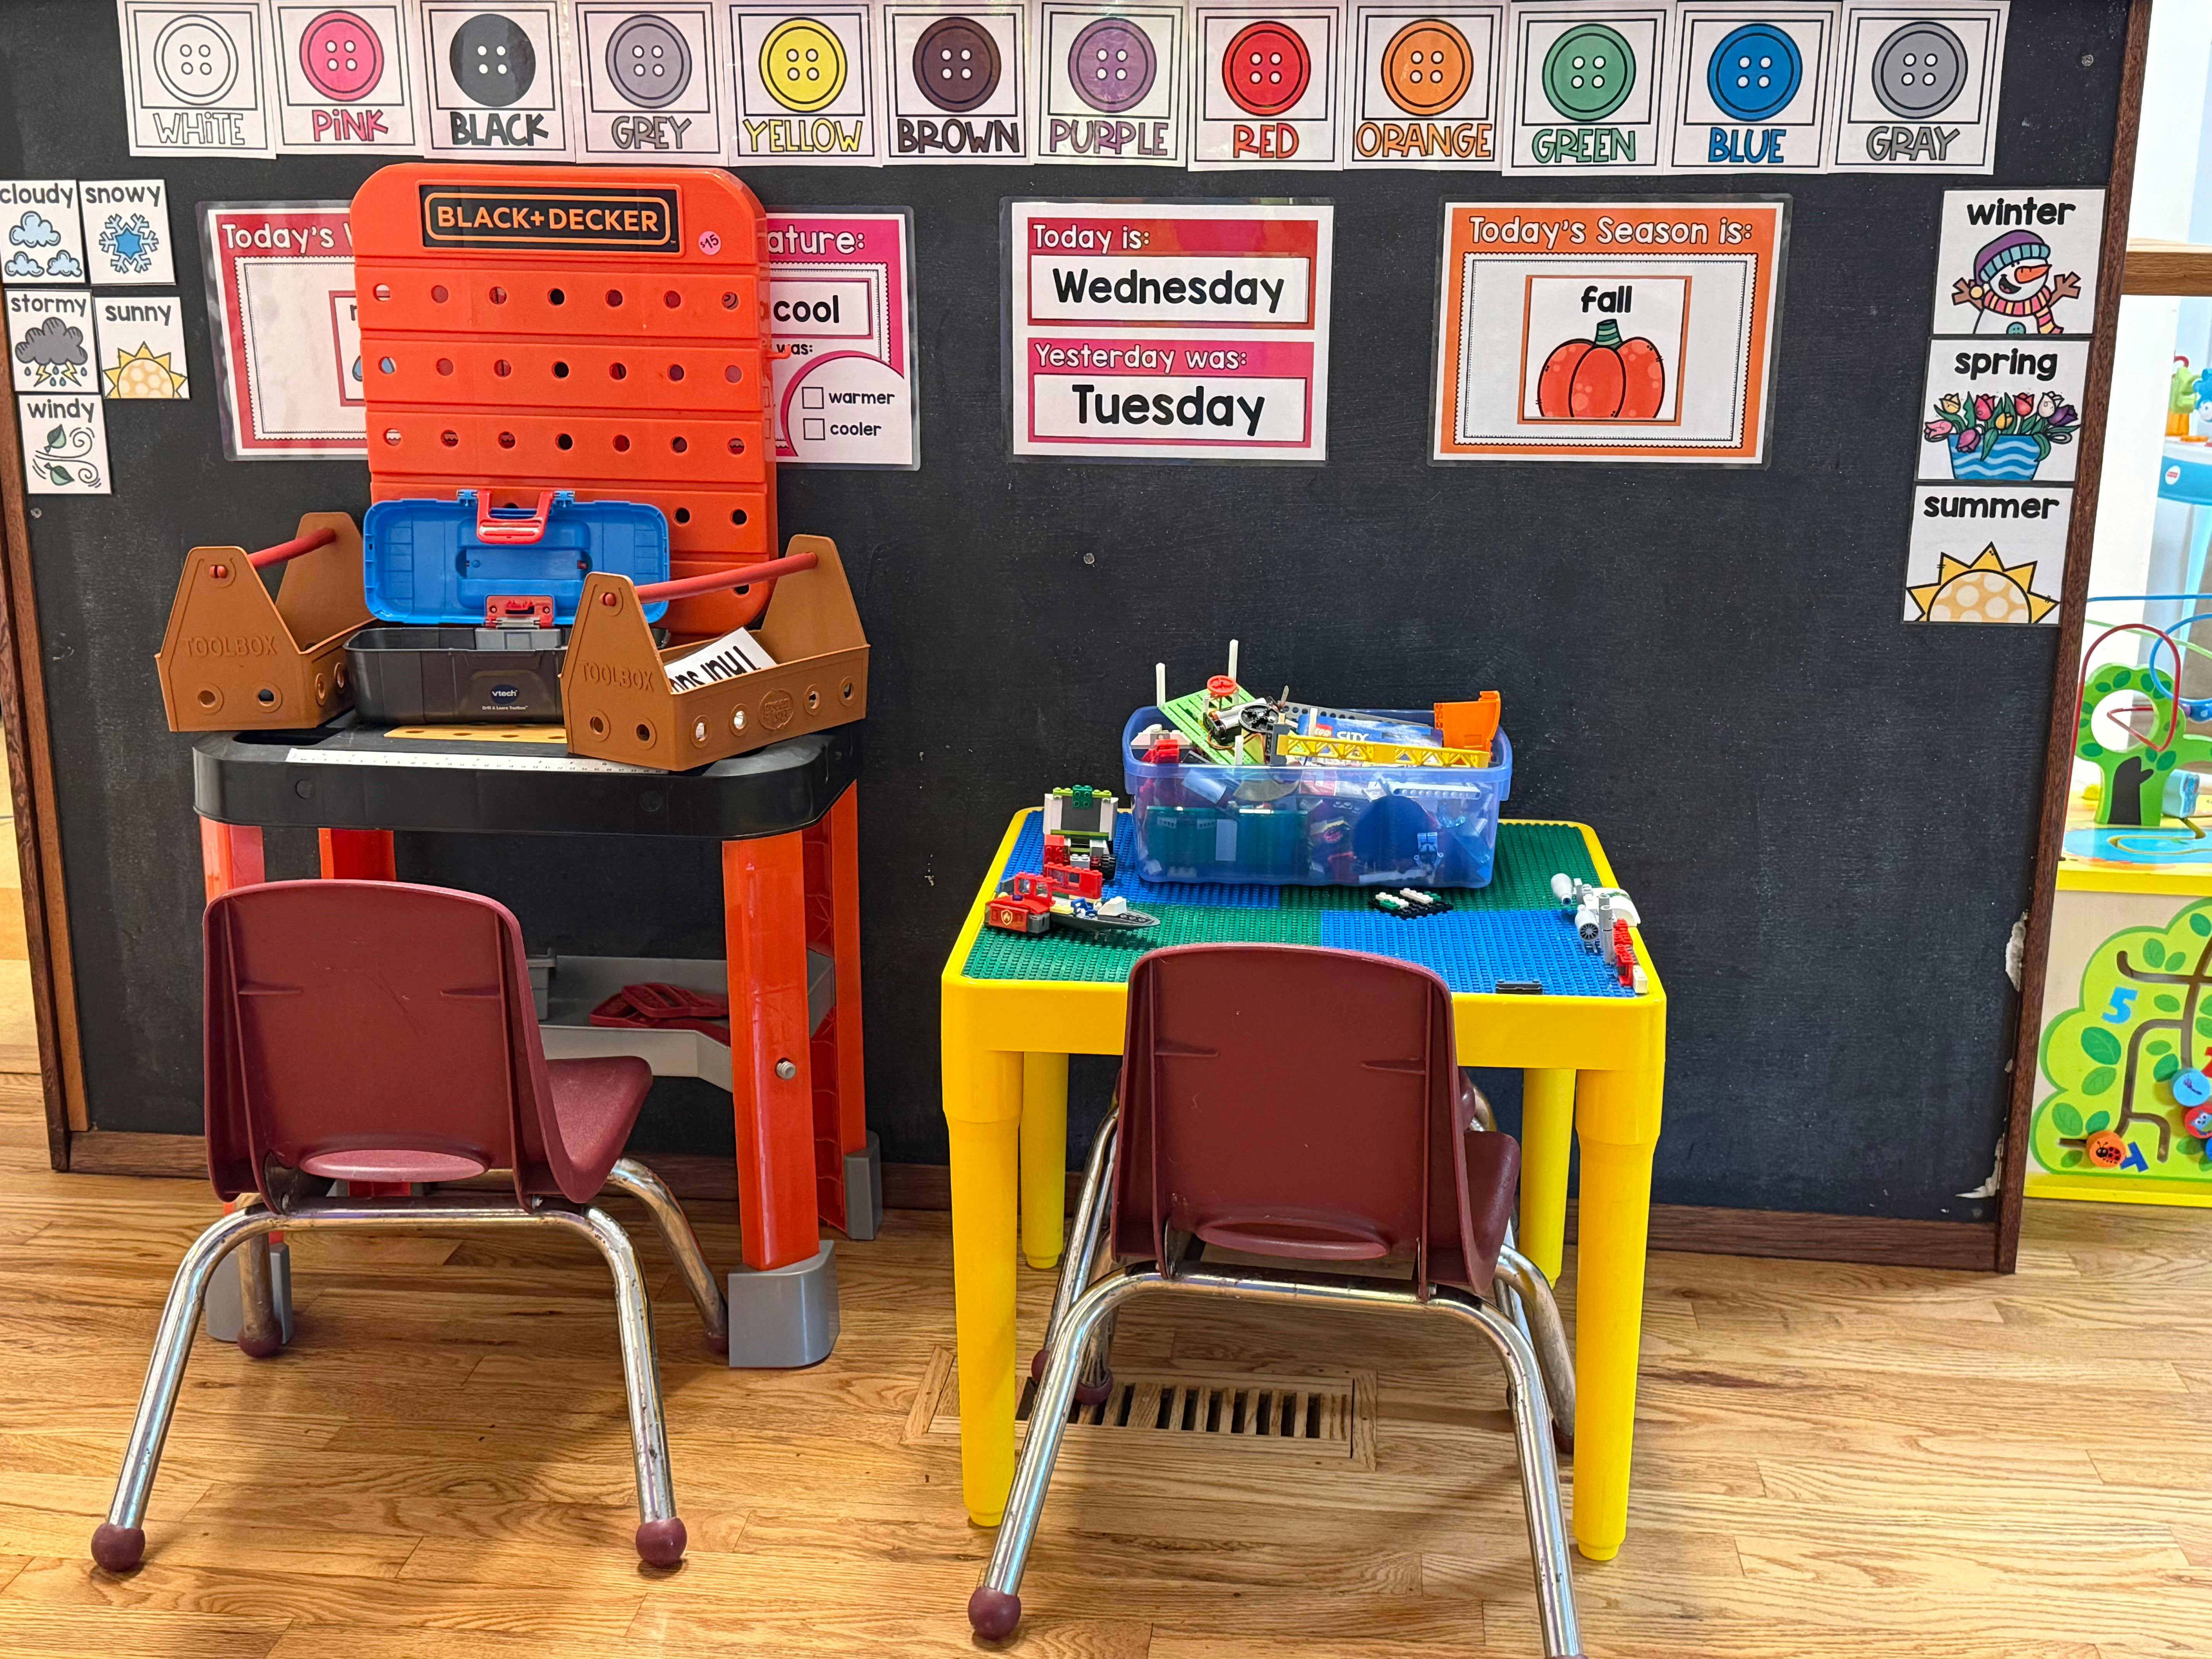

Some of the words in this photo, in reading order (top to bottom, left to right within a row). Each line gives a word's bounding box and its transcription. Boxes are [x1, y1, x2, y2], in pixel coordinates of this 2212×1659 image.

[450, 111, 549, 146] BLACK
[611, 116, 692, 151] GREY
[743, 118, 863, 153] YELLOW
[897, 118, 1020, 154] BROWN
[1050, 119, 1169, 156] PURPLE
[1233, 123, 1299, 159] RED
[1357, 122, 1492, 158] ORANGE
[1866, 125, 1960, 161] GRAY
[1531, 128, 1636, 164] GREEN
[1709, 127, 1787, 164] BLUE
[0, 182, 74, 207] cloudy
[86, 182, 161, 207] snowy
[1966, 197, 2076, 225] winter
[221, 223, 335, 254] Today's
[700, 234, 719, 248] $15
[768, 224, 865, 255] ature:
[1032, 223, 1113, 254] Today
[1122, 226, 1151, 250] is:
[1470, 216, 1586, 251] Today's
[1596, 216, 1708, 247] Season
[1717, 217, 1753, 246] is:
[11, 294, 87, 317] stormy
[1053, 268, 1285, 314] Wednesday
[1581, 285, 1633, 314] fall
[105, 303, 172, 326] sunny
[773, 295, 840, 323] cool
[1034, 343, 1175, 374] Yesterday
[1185, 350, 1247, 370] was:
[1954, 348, 2057, 381] spring
[27, 398, 95, 423] windy
[829, 392, 895, 405] warmer
[1072, 384, 1265, 436] Tuesday
[830, 421, 882, 436] cooler
[1923, 495, 2060, 519] summer
[181, 635, 277, 658] TOOLBOX
[579, 660, 654, 692] TOOLBOX
[2102, 987, 2138, 1024] 5
